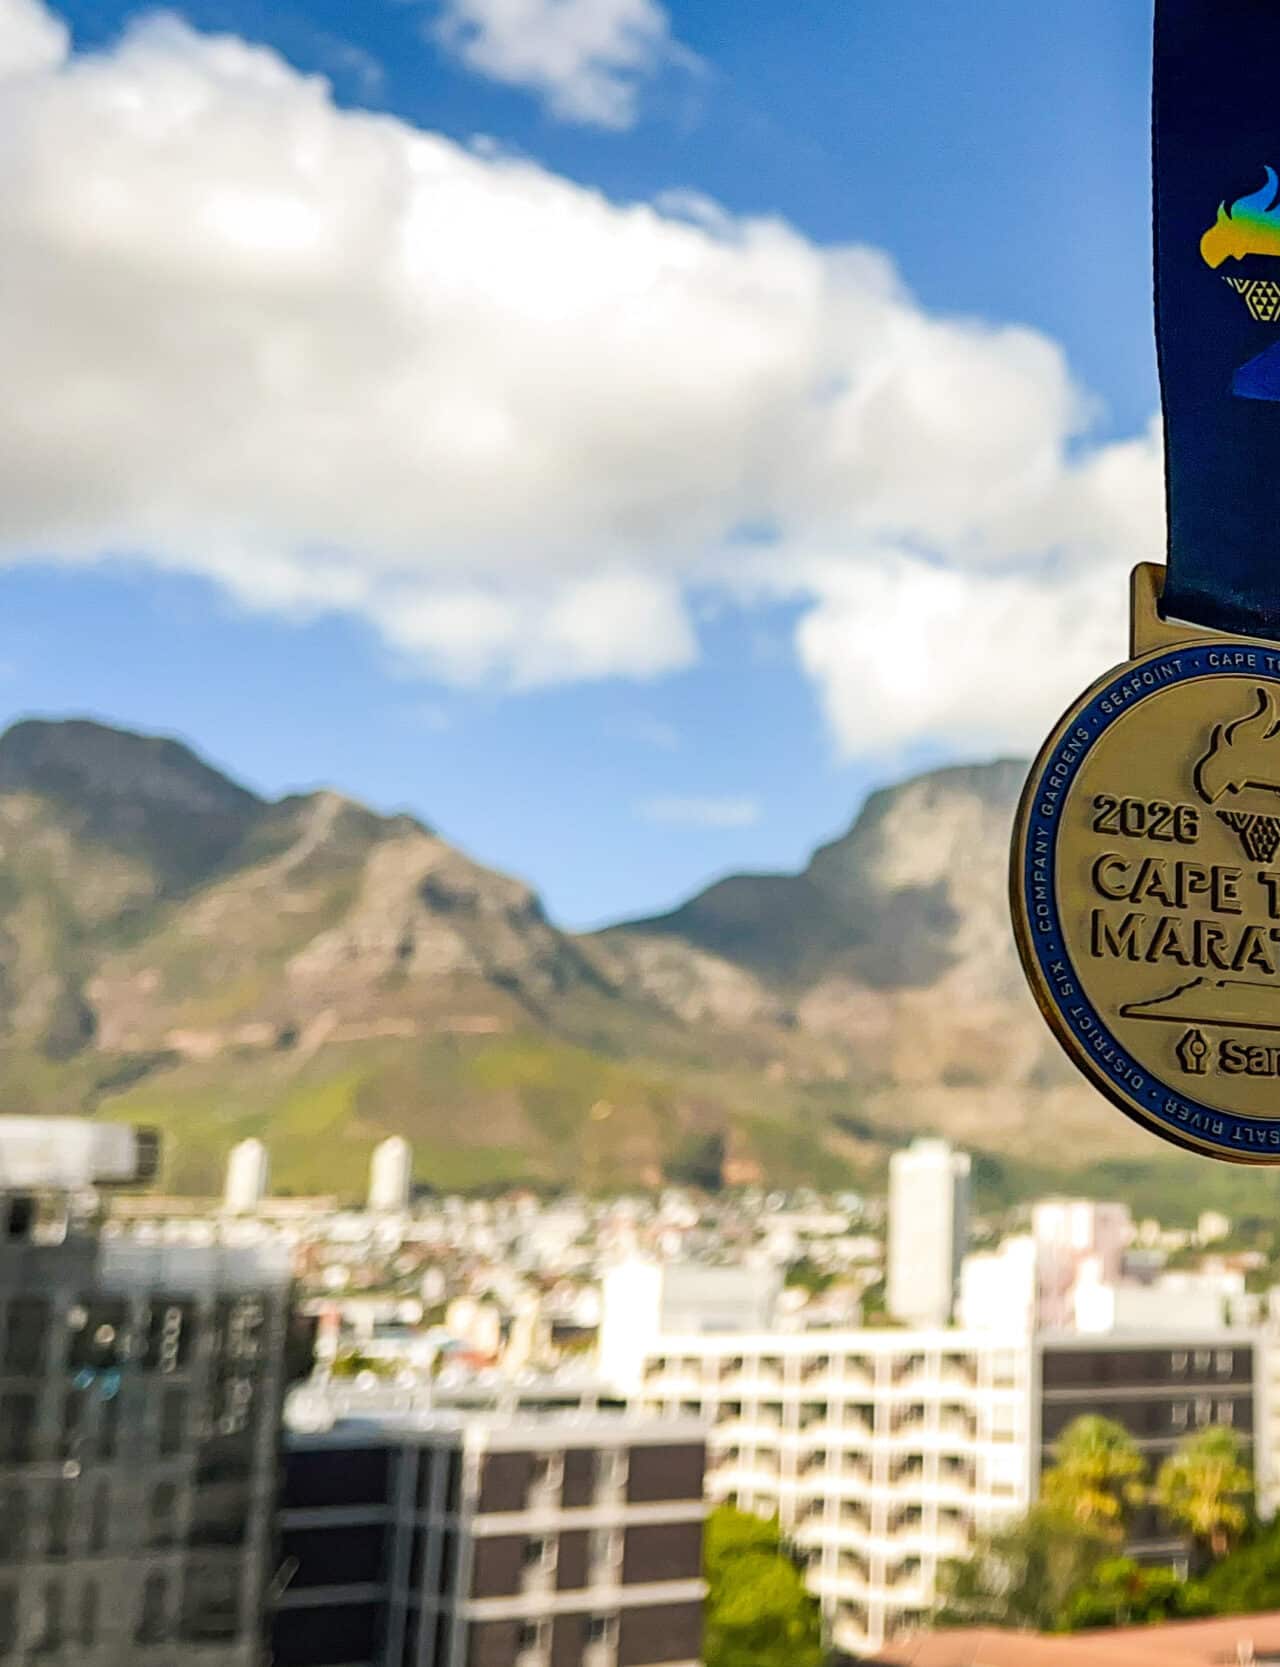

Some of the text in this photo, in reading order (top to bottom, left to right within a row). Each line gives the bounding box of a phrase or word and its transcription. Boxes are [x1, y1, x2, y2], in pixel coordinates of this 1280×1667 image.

[1100, 659, 1184, 713] SEAPOINT
[1209, 653, 1257, 667] CAPE
[1033, 728, 1089, 932] COMPANY GARDENS
[1092, 795, 1200, 843] 2026
[1092, 853, 1243, 914] CAPE
[1051, 961, 1144, 1090] DISTRICT SIX
[1165, 1098, 1280, 1144] SALT RIVER
